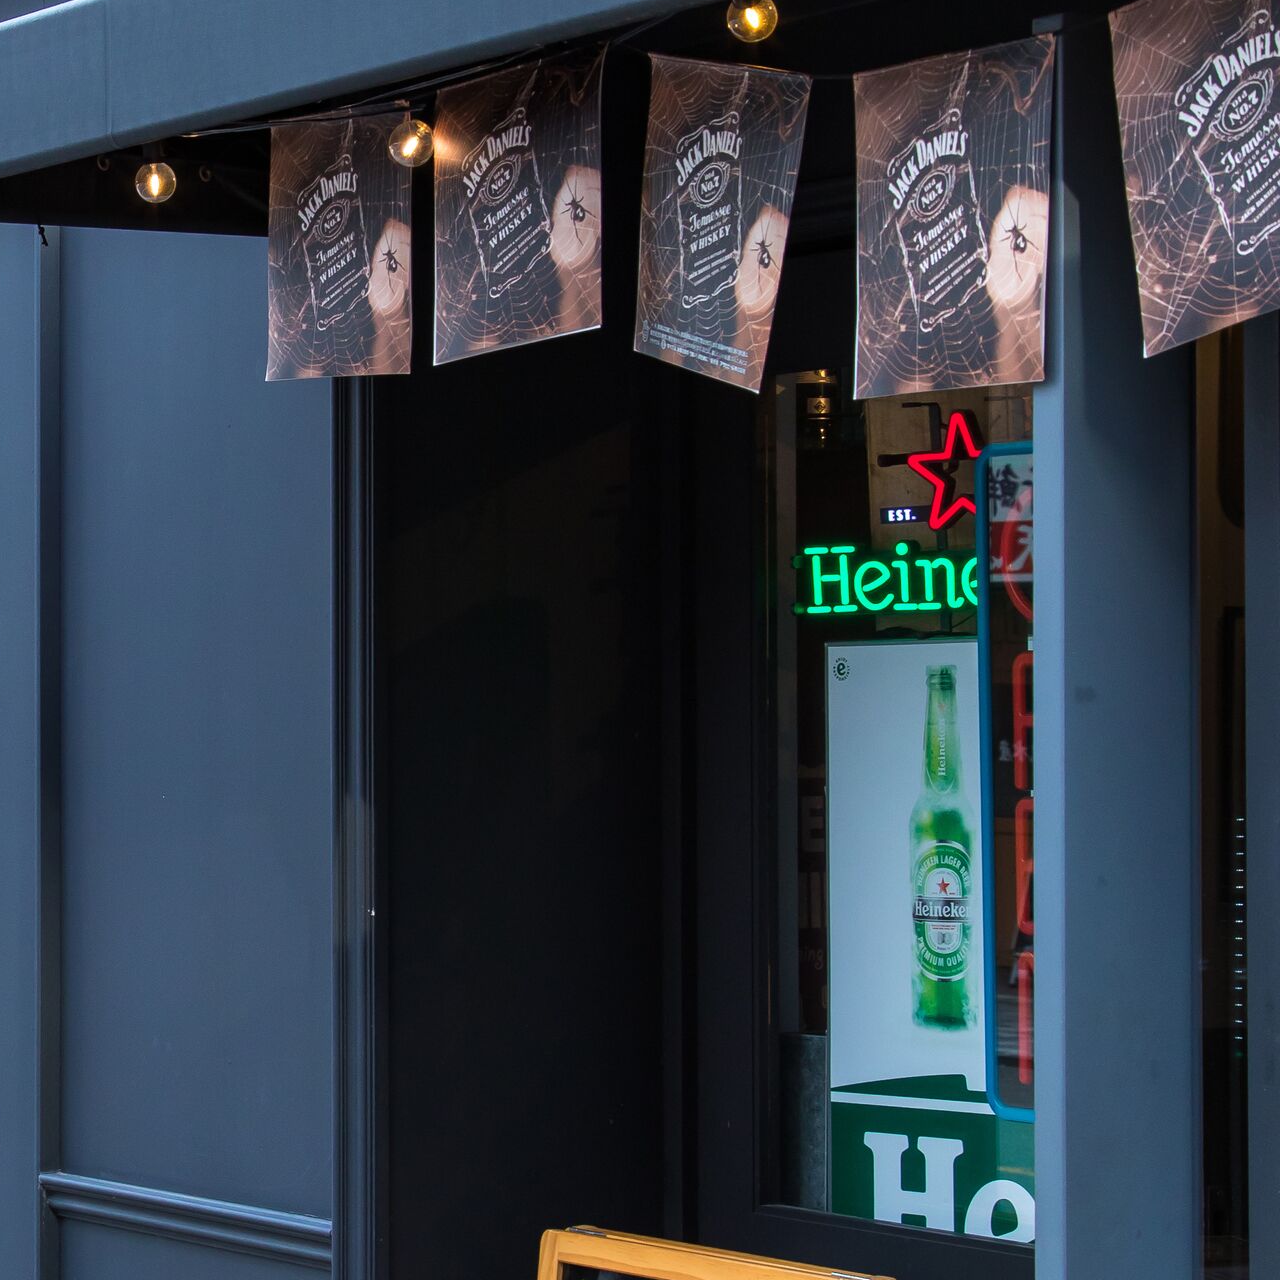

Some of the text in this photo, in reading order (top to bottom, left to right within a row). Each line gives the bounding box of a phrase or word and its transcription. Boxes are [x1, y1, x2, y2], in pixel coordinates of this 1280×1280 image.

[1178, 75, 1222, 138] JACK
[463, 120, 532, 198] JACK DANIEL'S
[675, 128, 742, 186] JACK DANIEL'S
[888, 125, 968, 210] JACK DANIEL'S
[298, 167, 358, 232] JACK DANIEL'S
[488, 203, 533, 249] WHISKEY
[690, 223, 731, 254] WHISKEY
[919, 224, 969, 275] WHISKEY
[320, 247, 358, 284] WHISKEY
[887, 508, 917, 522] EST.
[940, 855, 961, 869] LAGER
